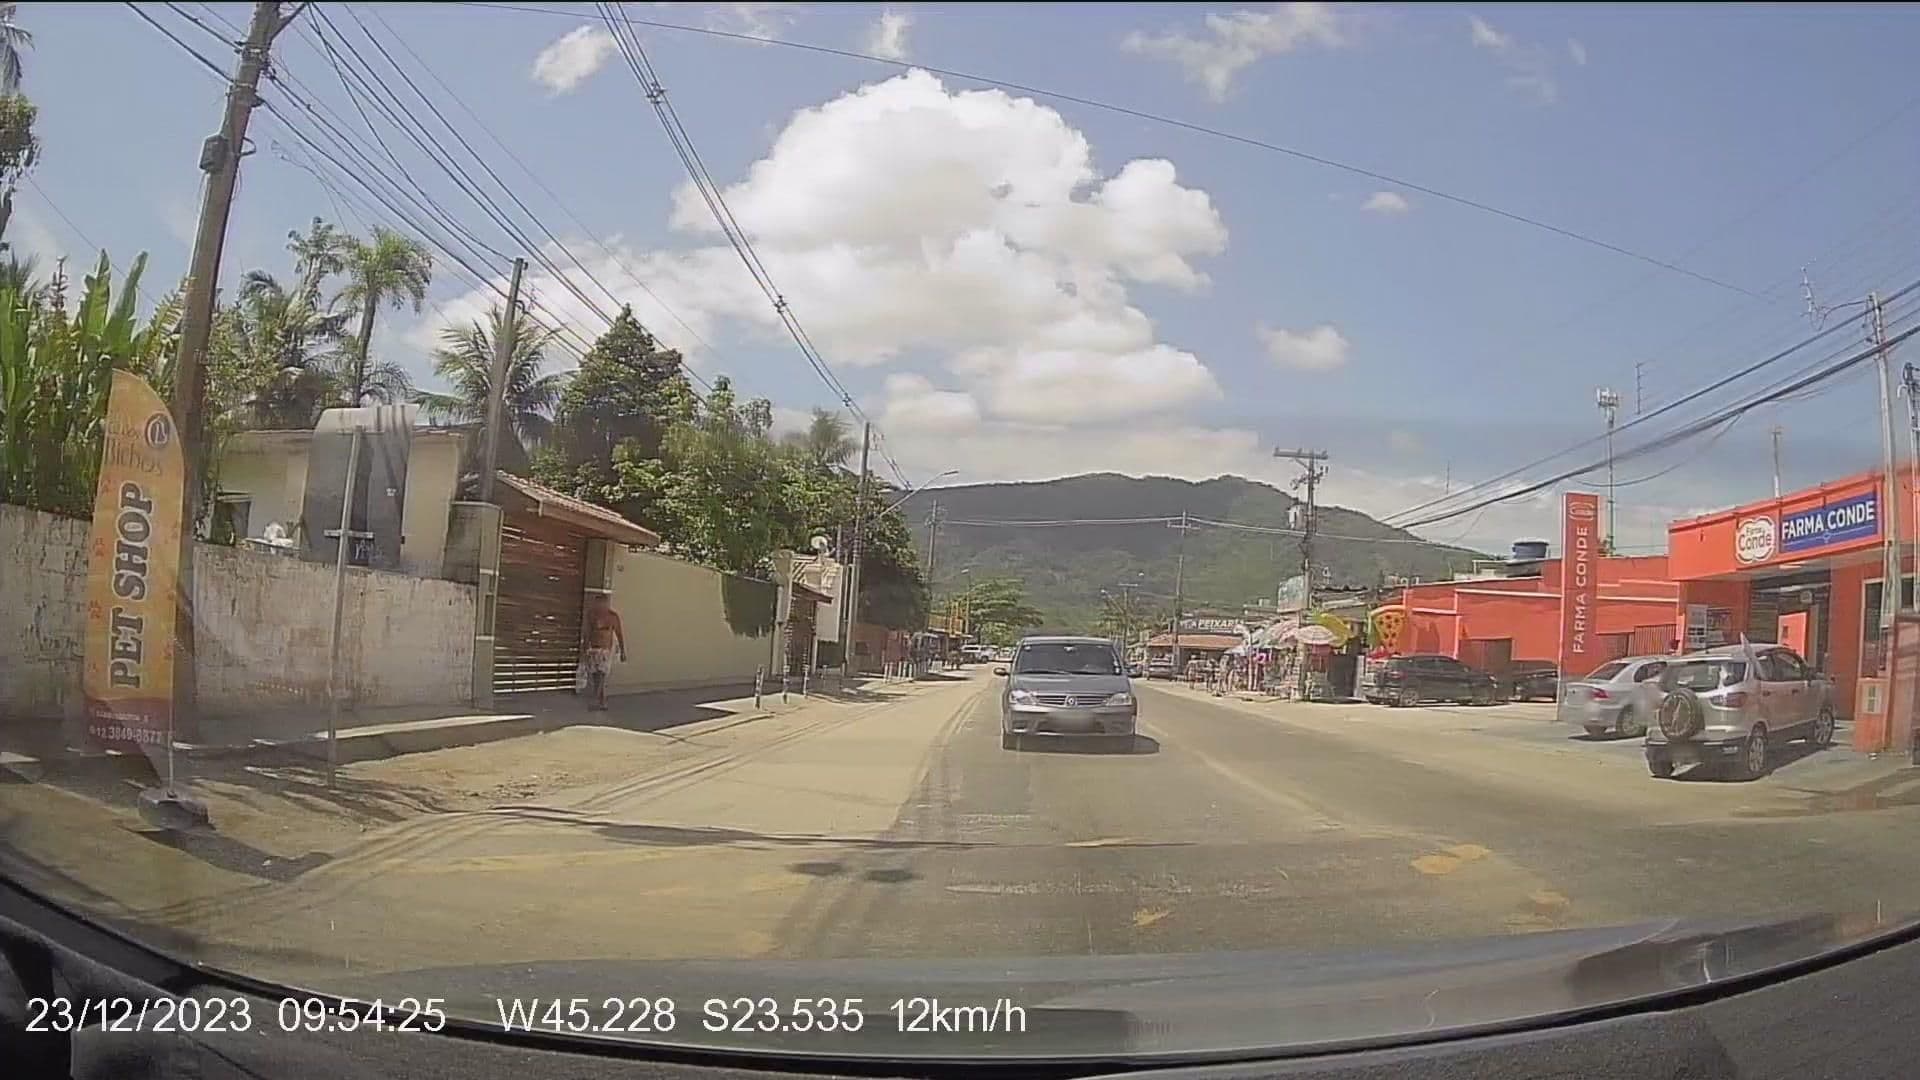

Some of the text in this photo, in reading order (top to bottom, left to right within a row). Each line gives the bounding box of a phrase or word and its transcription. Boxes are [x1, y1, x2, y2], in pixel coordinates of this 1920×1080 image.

[113, 481, 154, 601] SHOP
[1738, 532, 1772, 552] Conde
[1781, 500, 1876, 541] FARMA CONDE
[1575, 526, 1588, 587] CONDE
[110, 606, 144, 690] PET
[1573, 592, 1588, 653] FARMA
